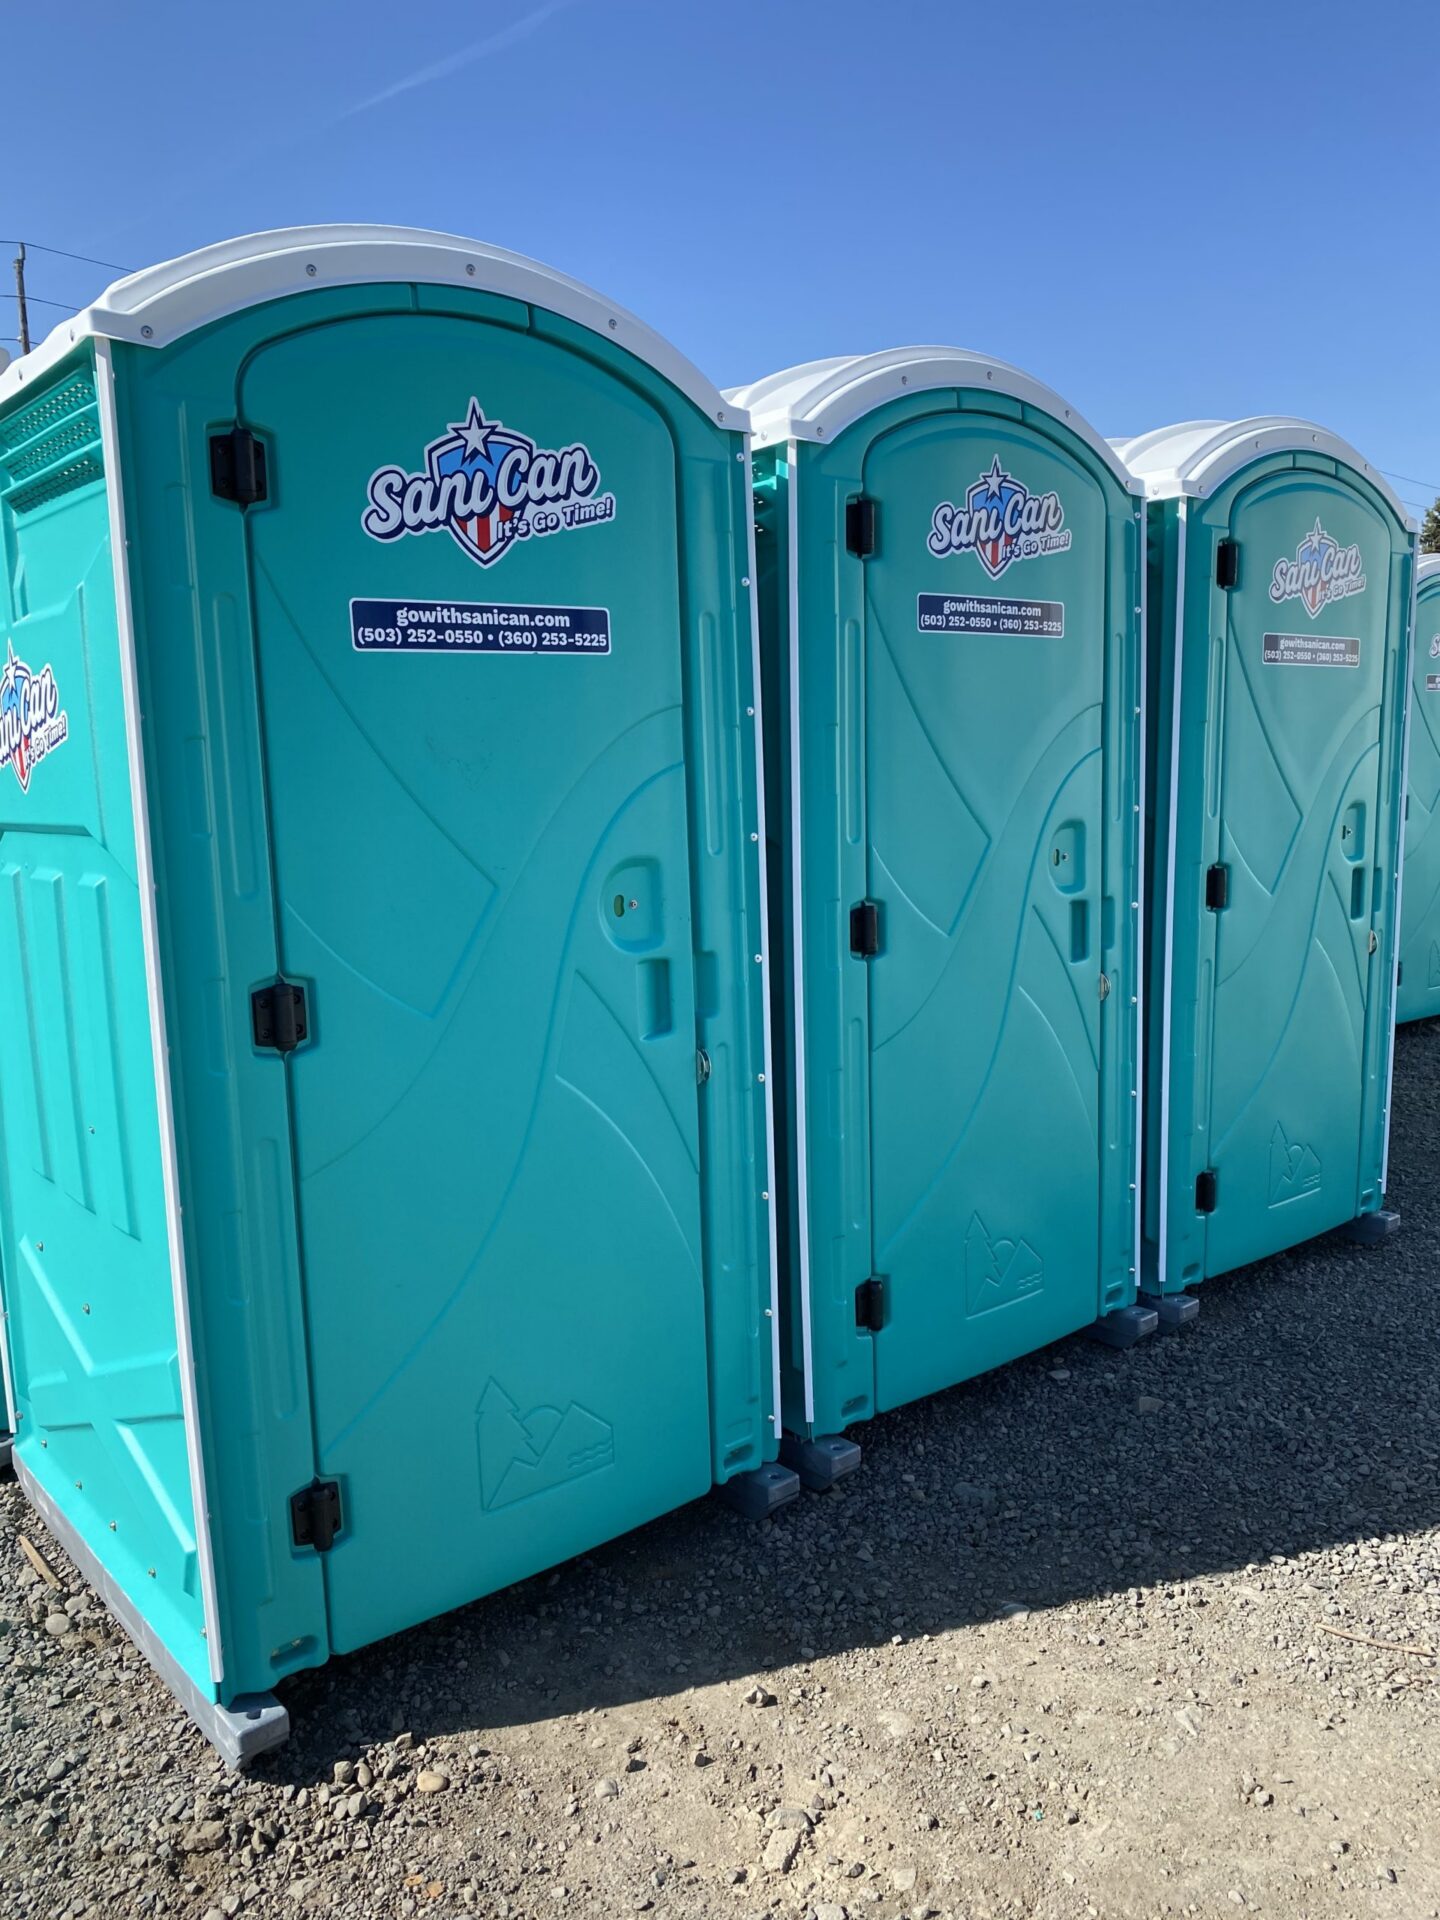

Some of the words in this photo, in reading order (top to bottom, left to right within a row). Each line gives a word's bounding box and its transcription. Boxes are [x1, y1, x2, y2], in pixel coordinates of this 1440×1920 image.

[365, 469, 494, 538] Sani
[497, 446, 595, 506] Can
[533, 510, 560, 532] Go
[562, 498, 612, 524] Time!
[929, 504, 1002, 554] Sani
[1003, 493, 1061, 535] Can
[1023, 540, 1038, 557] Go
[1040, 532, 1069, 552] Time!
[1321, 546, 1361, 582] Can
[396, 606, 570, 628] gowithsanican.com
[943, 600, 1042, 617] gowithsanican.com
[920, 614, 946, 628] (503)
[949, 615, 991, 628] 252-0550
[999, 618, 1022, 632] (360)
[1023, 619, 1062, 632] 253-5225
[357, 627, 402, 645] (503)
[407, 628, 483, 644] 252-0550
[498, 631, 538, 648] (360)
[541, 632, 607, 646] 253-5225
[1280, 638, 1346, 650] gowithsanican.com
[20, 668, 57, 736] Can
